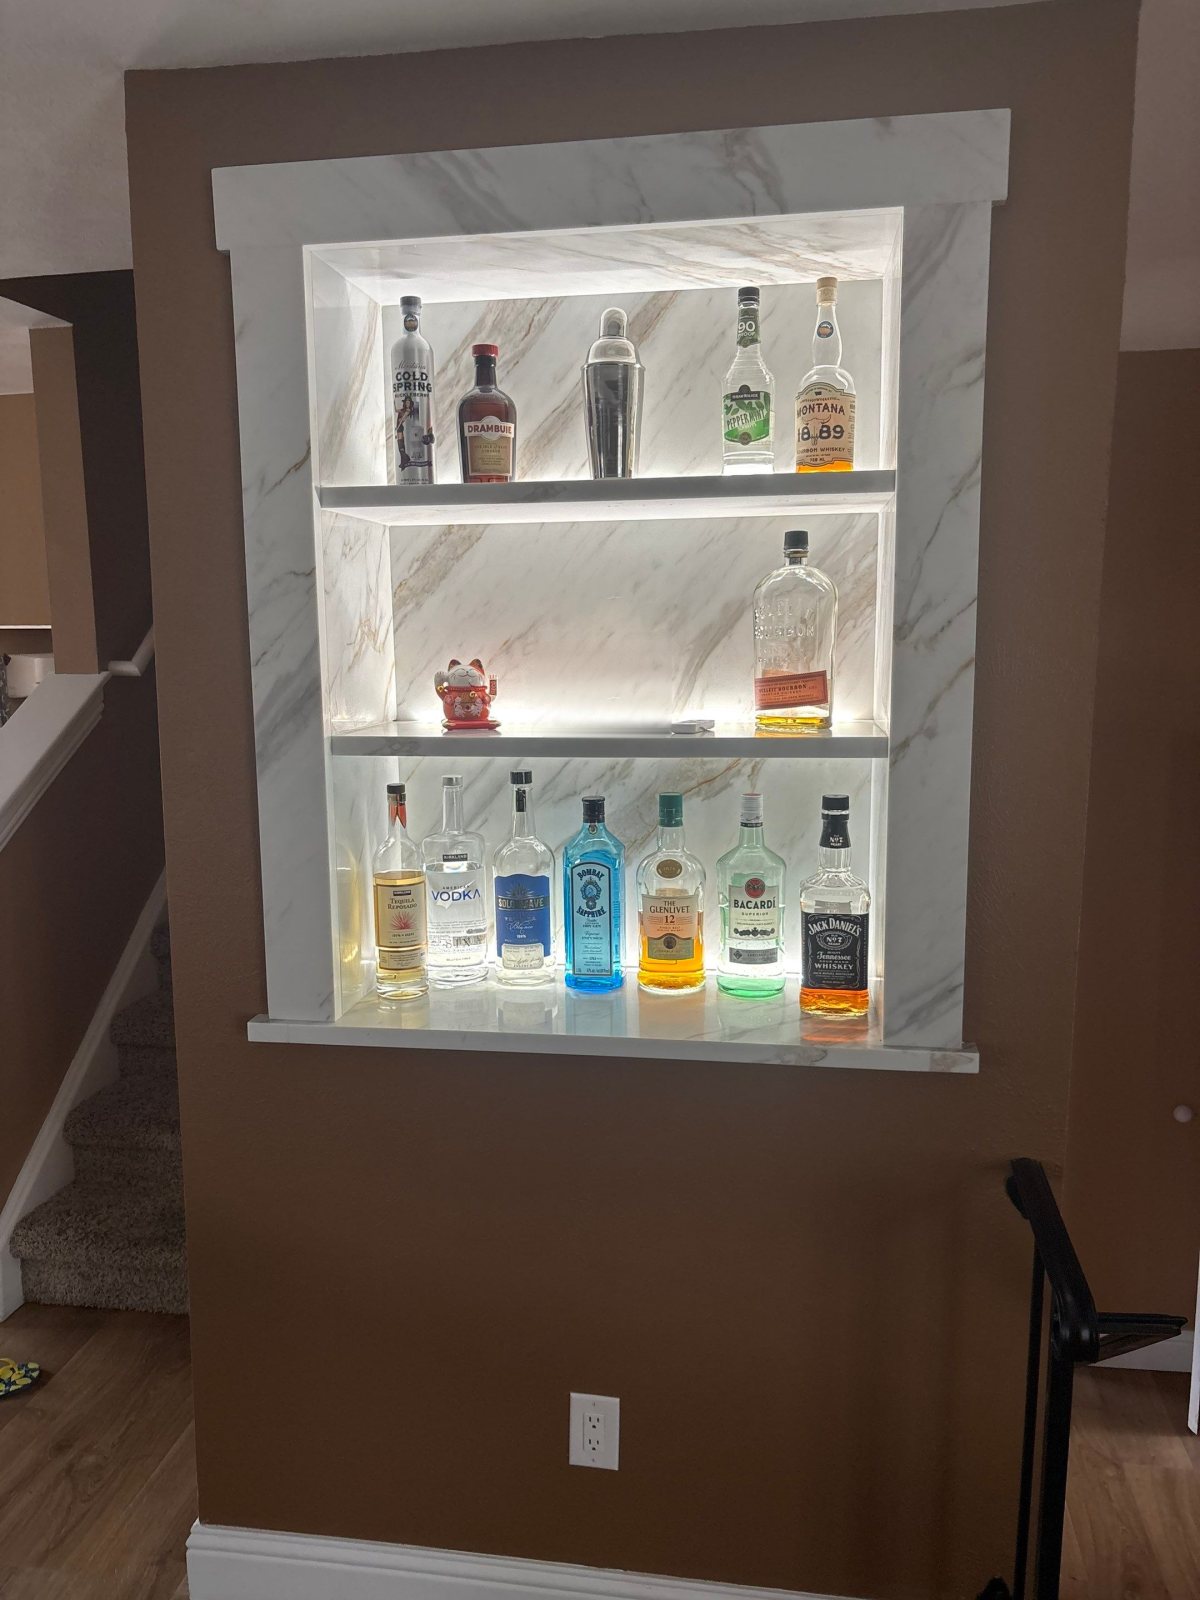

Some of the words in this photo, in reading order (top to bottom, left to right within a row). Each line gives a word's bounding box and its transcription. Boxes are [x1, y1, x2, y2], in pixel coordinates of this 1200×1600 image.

[738, 320, 756, 333] 90
[395, 371, 429, 382] COLD
[392, 381, 433, 393] SPRING
[797, 402, 846, 419] MONTANA
[467, 424, 513, 434] DRAMBUIE
[778, 683, 807, 692] BOURBON
[577, 868, 605, 881] BOMBAY
[431, 888, 481, 902] VODKA
[390, 897, 415, 905] TEQUILA
[733, 896, 776, 910] BACARDÍ
[576, 905, 607, 918] SAPPHIRE
[649, 905, 690, 914] GLENLIVET
[664, 914, 676, 924] 12
[808, 920, 829, 936] JACK
[816, 950, 852, 961] Tennessee
[814, 962, 854, 970] WHISKEY
